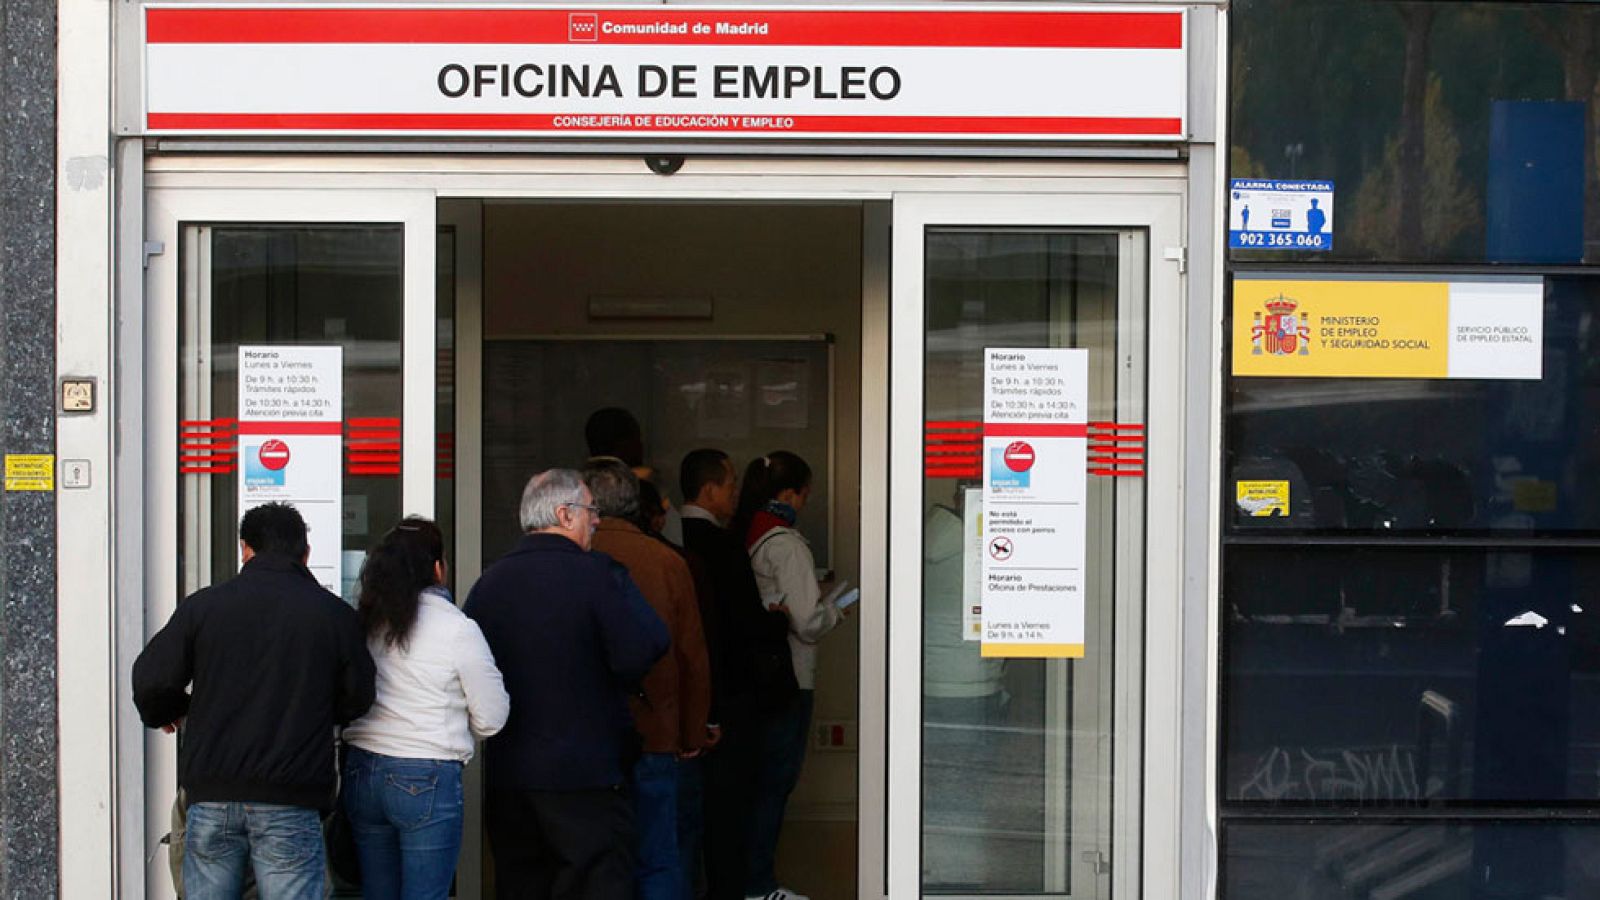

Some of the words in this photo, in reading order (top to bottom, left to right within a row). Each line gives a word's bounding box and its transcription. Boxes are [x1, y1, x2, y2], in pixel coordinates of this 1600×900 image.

[601, 21, 687, 36] Comunidad
[692, 22, 712, 36] de
[716, 21, 769, 36] Madrid
[437, 63, 623, 98] OFICINA
[637, 64, 698, 99] DE
[713, 65, 902, 100] EMPLEO
[553, 113, 632, 127] CONSEJERÍA
[635, 116, 653, 127] DE
[655, 114, 730, 128] EDUCACIÓN
[731, 117, 741, 128] Y
[742, 117, 794, 129] EMPLEO
[1240, 233, 1264, 245] 902
[1268, 233, 1293, 246] 365
[1297, 234, 1322, 246] 060
[1320, 316, 1380, 326] MINISTERIO
[1320, 328, 1336, 337] DE
[1337, 328, 1378, 337] EMPLEO
[1457, 326, 1492, 334] SERVICIO
[1493, 324, 1528, 334] PÚBLICO
[1457, 334, 1467, 342] DE
[1502, 335, 1533, 343] ESTATAL
[1320, 339, 1328, 348] Y
[1330, 339, 1390, 349] SEGURIDAD
[1391, 340, 1430, 349] SOCIAL
[988, 574, 1022, 582] Horario
[988, 583, 1015, 591] Oficina
[1017, 583, 1026, 591] de
[1028, 583, 1077, 592] Prestaciones
[988, 631, 999, 639] De
